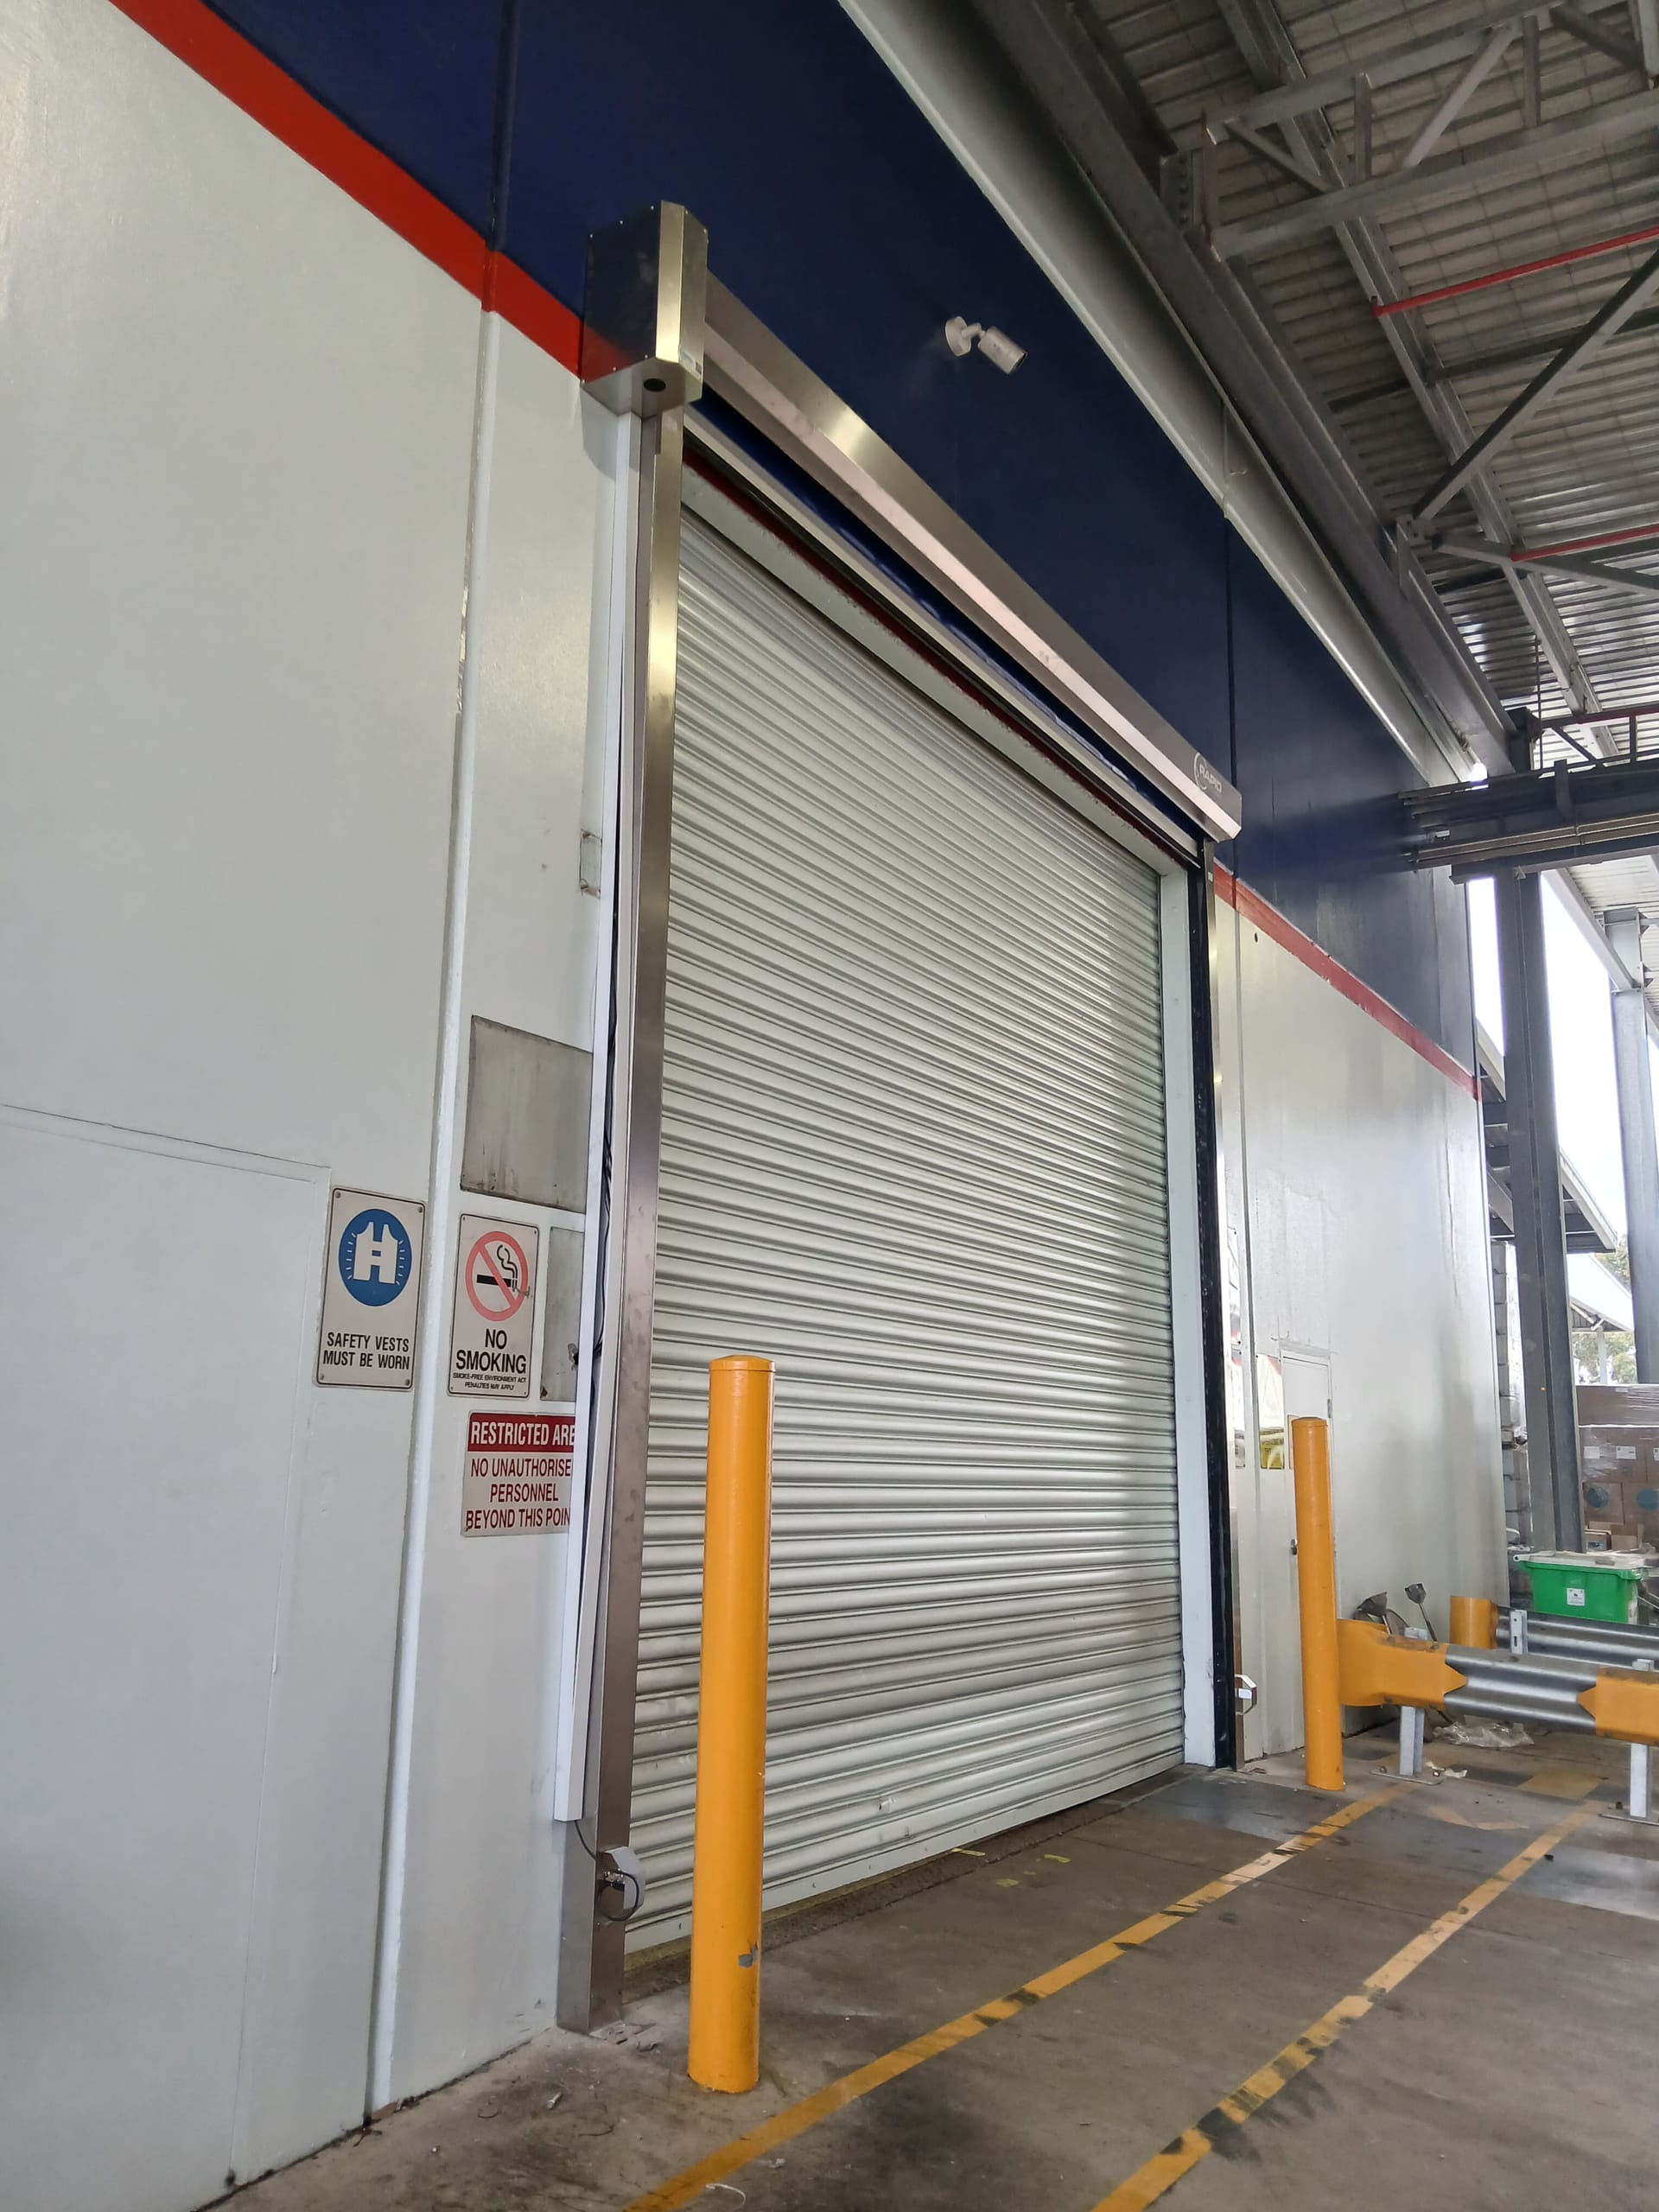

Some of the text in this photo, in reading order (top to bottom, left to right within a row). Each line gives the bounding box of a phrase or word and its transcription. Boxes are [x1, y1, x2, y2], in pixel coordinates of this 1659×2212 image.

[327, 1332, 410, 1352] SAFETY VESTS
[485, 1328, 507, 1350] NO
[323, 1350, 410, 1370] MUST BE WORN
[455, 1349, 526, 1374] SMOKING
[470, 1421, 575, 1446] RESTRICTED ARE
[471, 1458, 571, 1477] NO UNAUTHORISE
[490, 1483, 558, 1503] PERSONNEL
[466, 1507, 570, 1529] BEYOND THIS POIN
